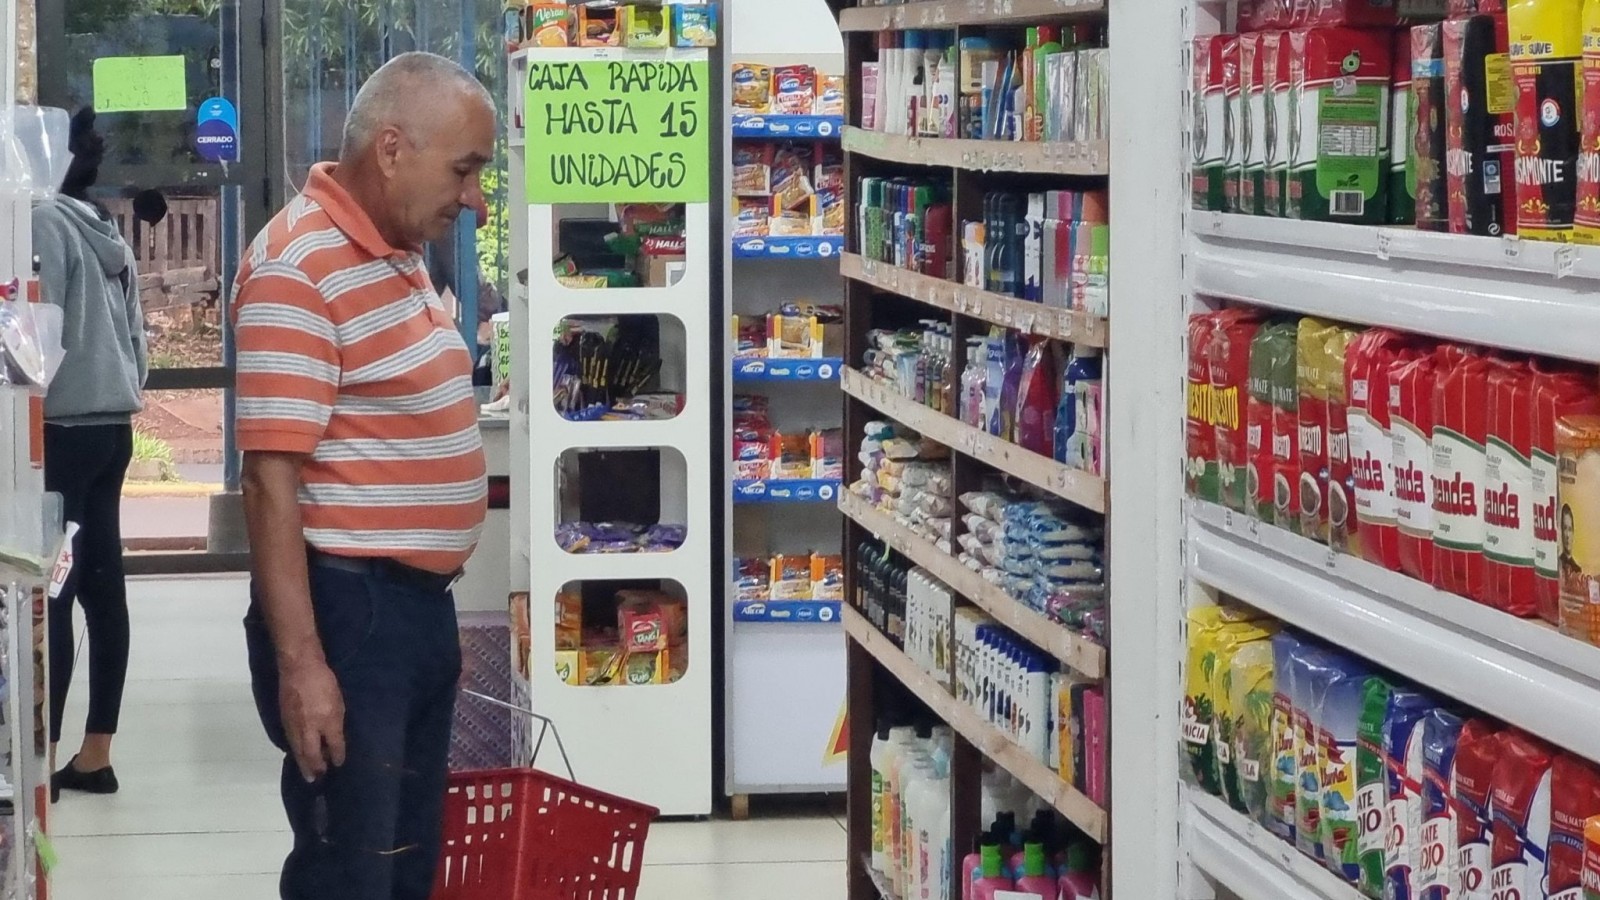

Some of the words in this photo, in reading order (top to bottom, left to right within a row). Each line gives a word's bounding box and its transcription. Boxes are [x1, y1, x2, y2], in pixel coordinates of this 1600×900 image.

[529, 63, 588, 90] CAJA
[545, 98, 638, 135] HASTA
[659, 100, 697, 138] 15
[1494, 124, 1515, 137] ROS
[197, 136, 233, 144] CERRADO
[1516, 157, 1564, 185] SAMONTE
[1187, 384, 1215, 426] ESITO
[1351, 450, 1385, 492] anda
[1395, 460, 1426, 503] anda
[1484, 482, 1520, 530] anda
[1533, 496, 1558, 542] and
[1419, 842, 1444, 872] OJO
[1459, 848, 1472, 869] ATE
